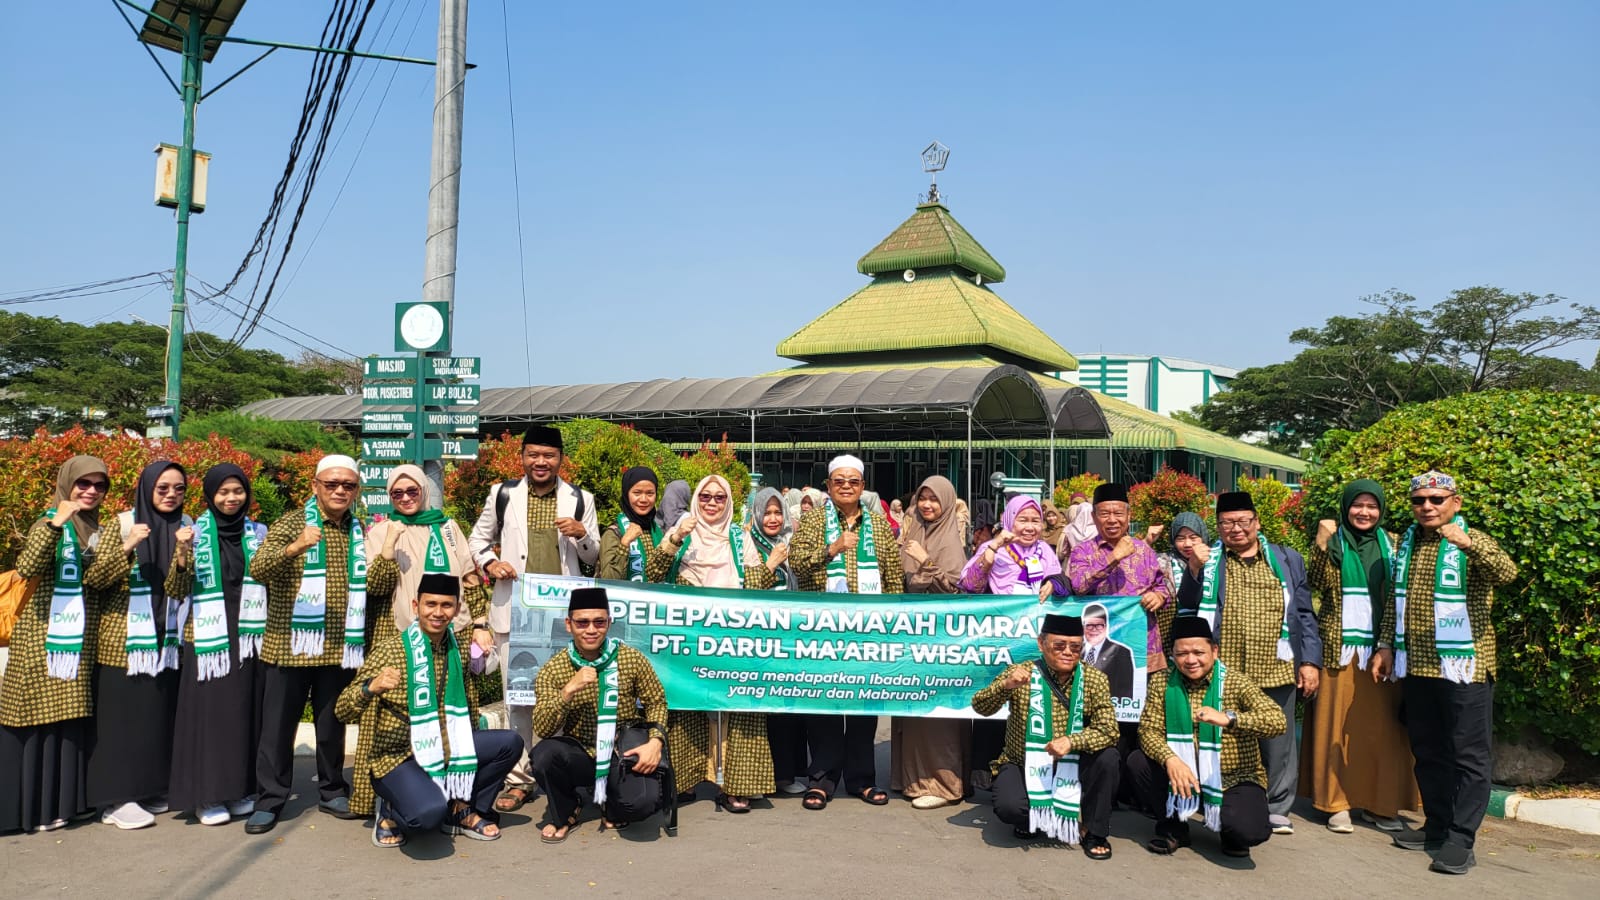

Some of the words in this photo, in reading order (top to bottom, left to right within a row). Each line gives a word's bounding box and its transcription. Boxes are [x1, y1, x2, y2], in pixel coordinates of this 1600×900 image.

[377, 360, 406, 373] MASJID
[432, 359, 452, 368] STKIP
[434, 367, 472, 375] INDRAMAYU
[433, 387, 447, 399] LAP.
[448, 387, 466, 399] BOLA
[467, 387, 473, 399] 2
[429, 414, 478, 425] WORKSHOP
[372, 441, 405, 449] ASRAMA
[441, 441, 461, 454] TPA
[375, 449, 402, 457] PUTRA
[365, 467, 382, 480] LAP.
[609, 600, 792, 631] PELEPASAN
[945, 613, 1045, 640] UMRA
[651, 633, 691, 656] PT.
[697, 635, 789, 659] DARUL
[909, 643, 1014, 666] WISATA
[762, 670, 866, 685] mendapatkan
[869, 673, 921, 687] Ibadah
[924, 675, 973, 688] Umrah
[727, 685, 766, 698] yang
[769, 685, 824, 699] Mabrur
[826, 687, 855, 699] dan
